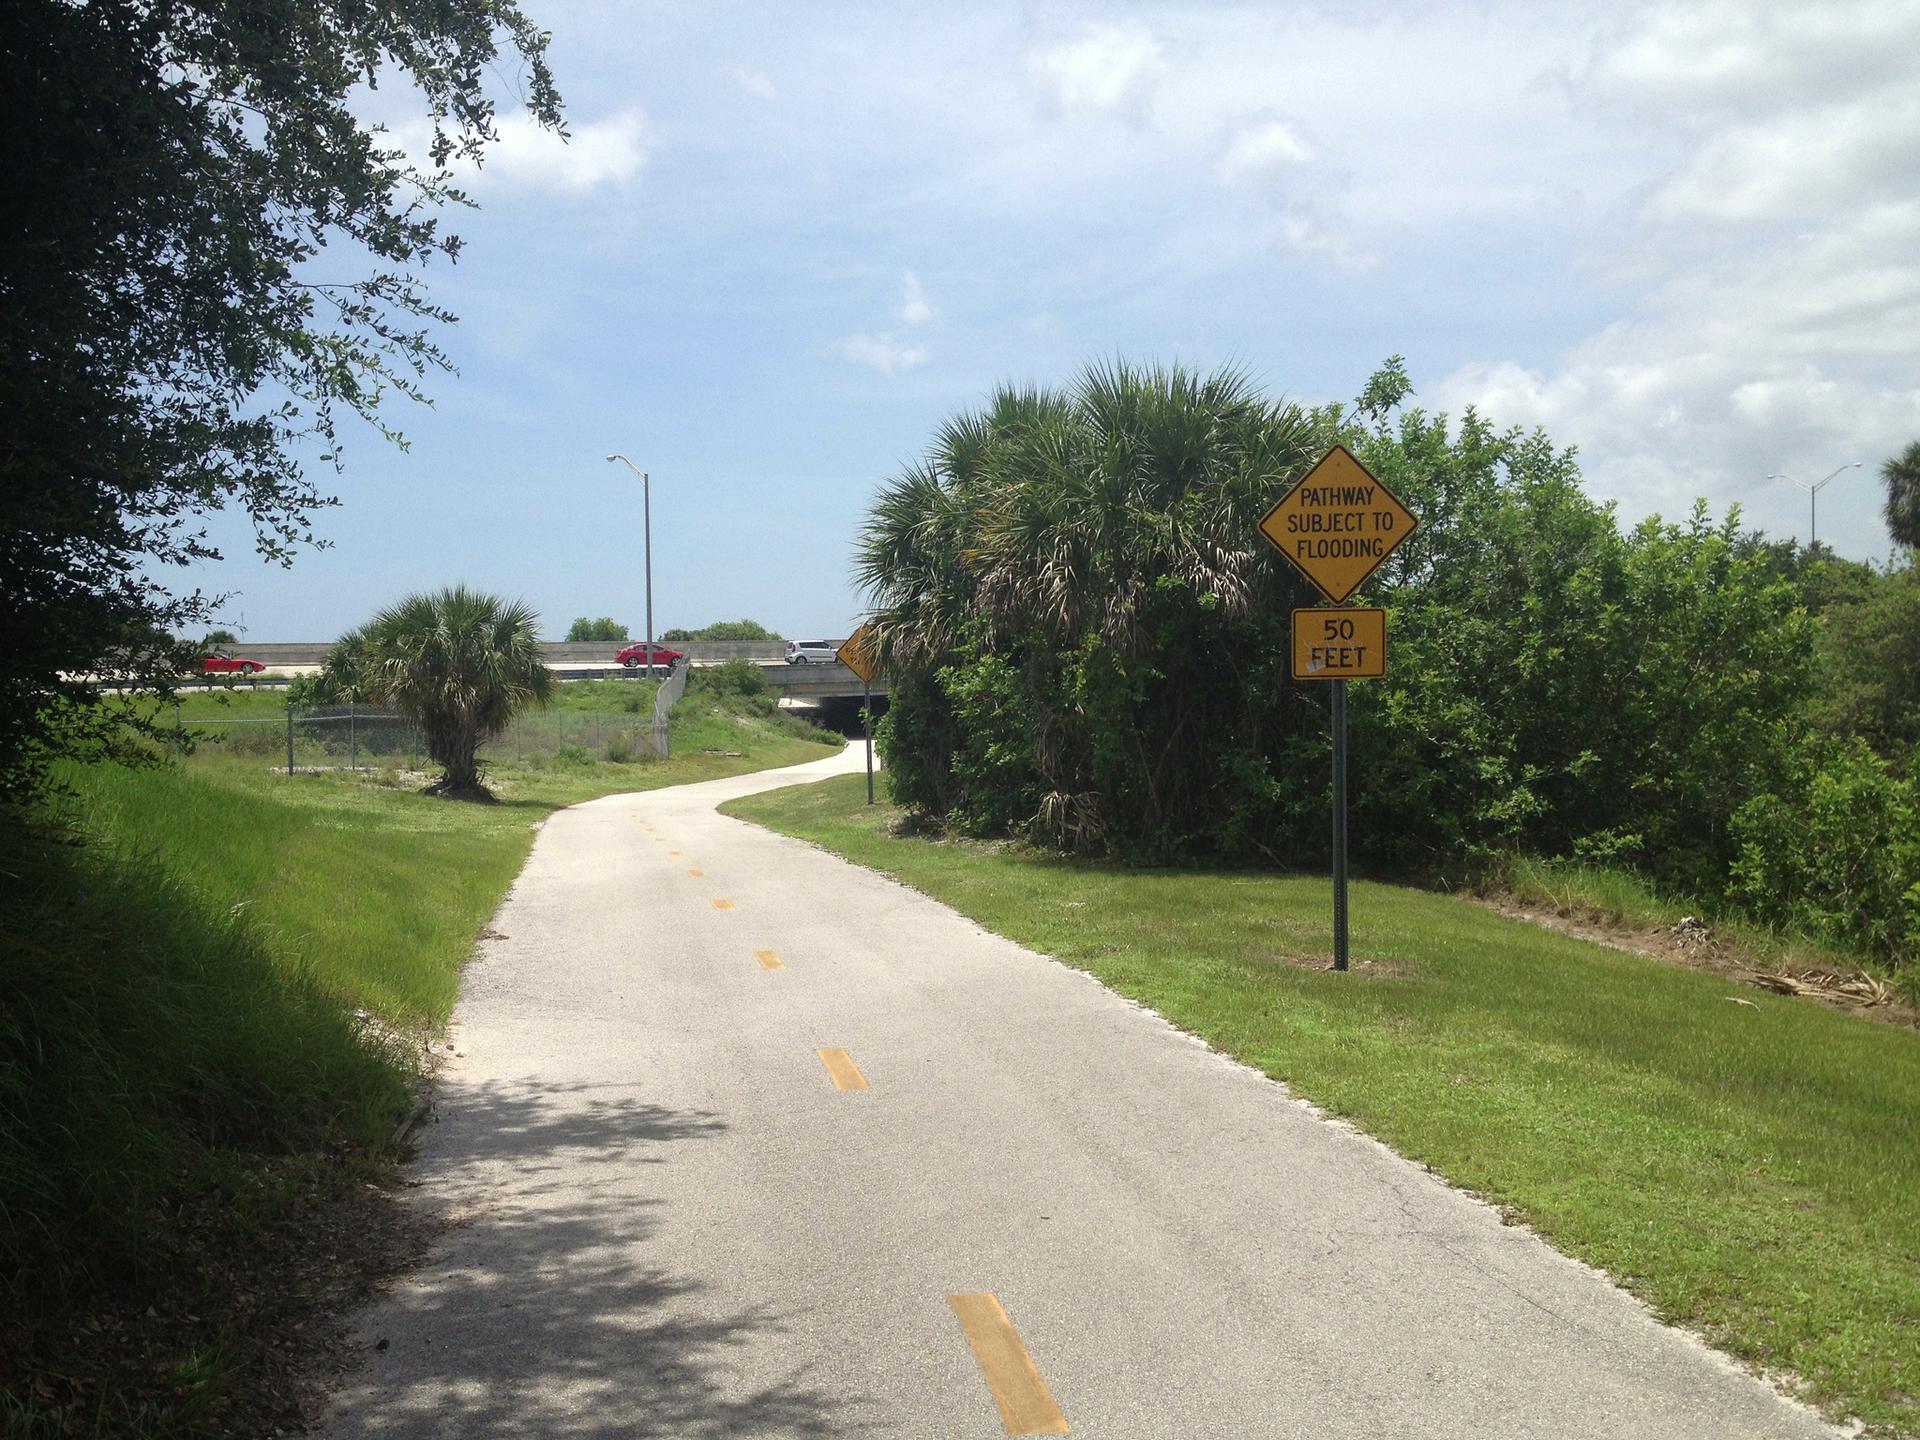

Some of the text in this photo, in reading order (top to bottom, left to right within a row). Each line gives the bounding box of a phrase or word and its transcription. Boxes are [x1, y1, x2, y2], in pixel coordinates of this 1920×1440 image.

[1301, 487, 1374, 506] PATHWAY
[1288, 512, 1393, 533] SUBJECT TO
[1297, 539, 1383, 558] FLOODING
[1324, 619, 1354, 640] 50
[1312, 647, 1366, 668] FEET
